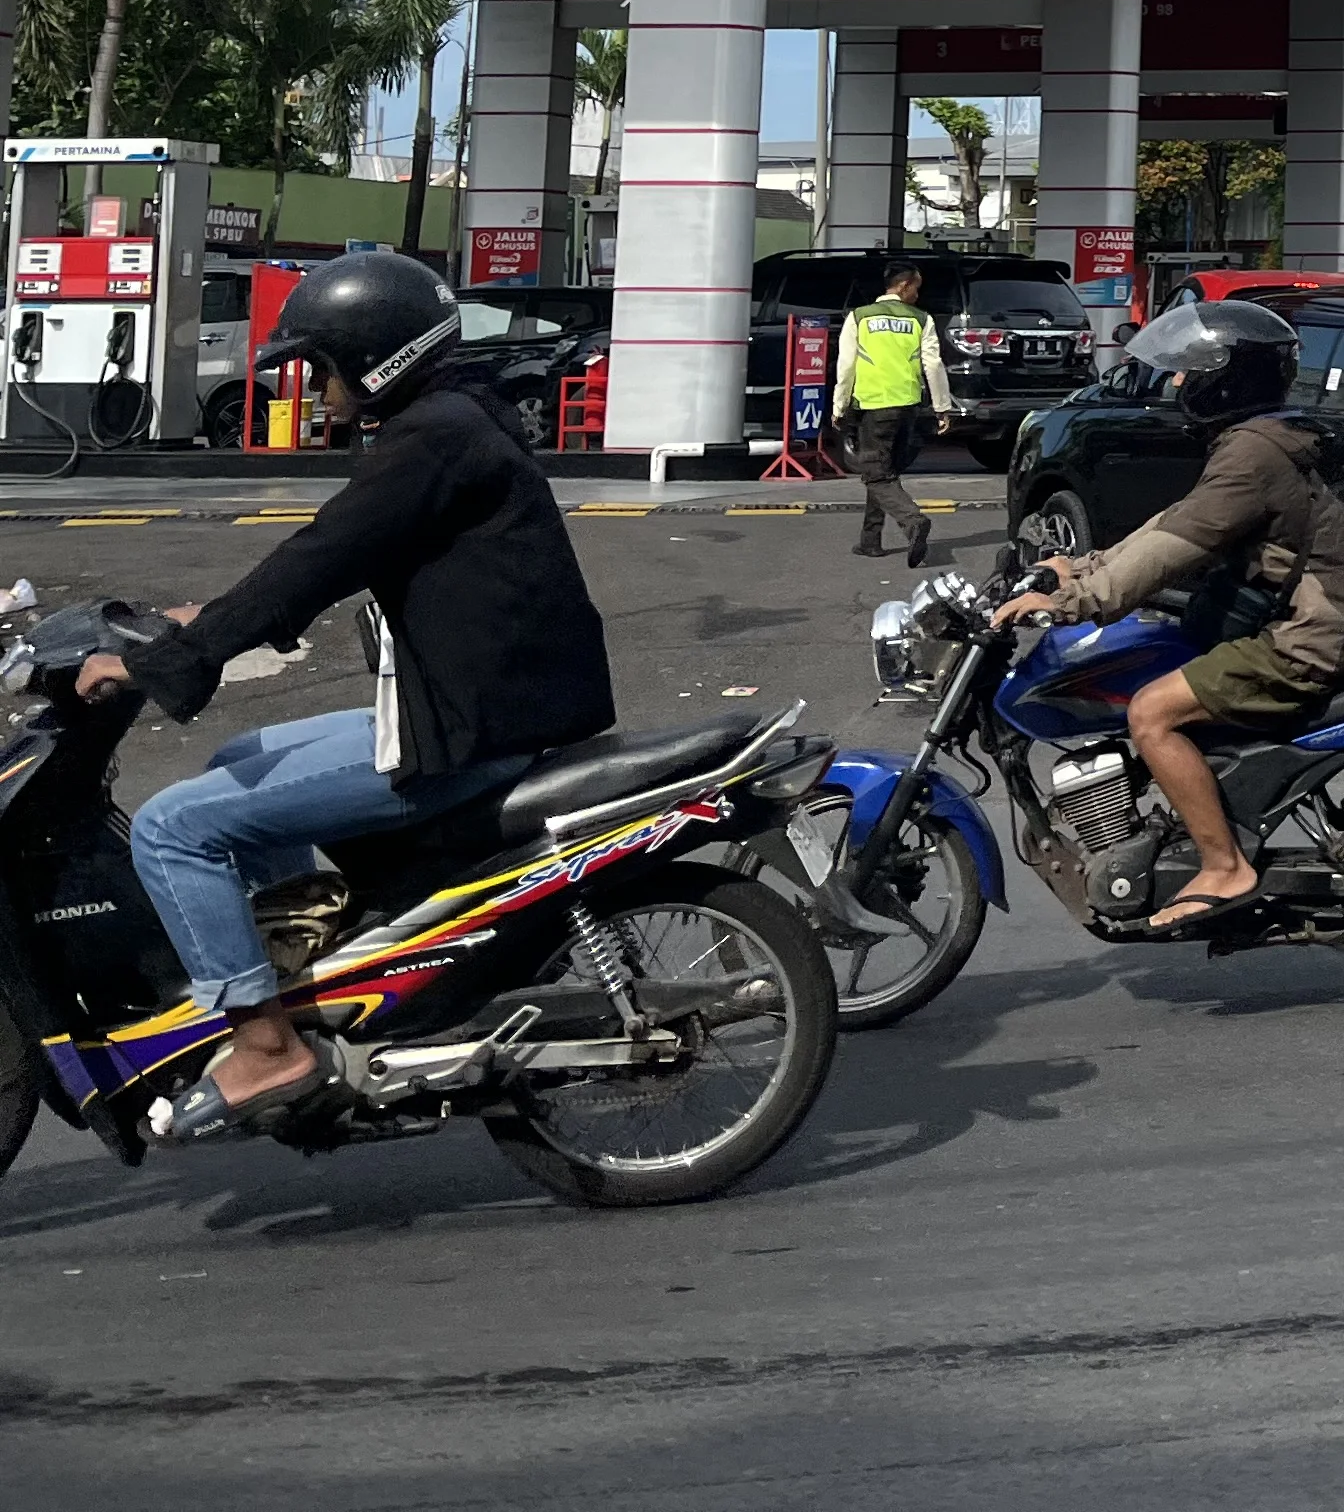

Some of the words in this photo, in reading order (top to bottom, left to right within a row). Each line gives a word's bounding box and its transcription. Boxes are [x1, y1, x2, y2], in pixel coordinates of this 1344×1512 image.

[1156, 3, 1174, 16] 98
[937, 41, 948, 58] 3
[54, 146, 121, 157] PERTAMINA
[494, 231, 536, 243] JALUR
[493, 242, 536, 252] KHUSUS
[377, 345, 419, 380] IPONE
[34, 900, 118, 924] HONDA
[383, 957, 455, 977] ASTREA
